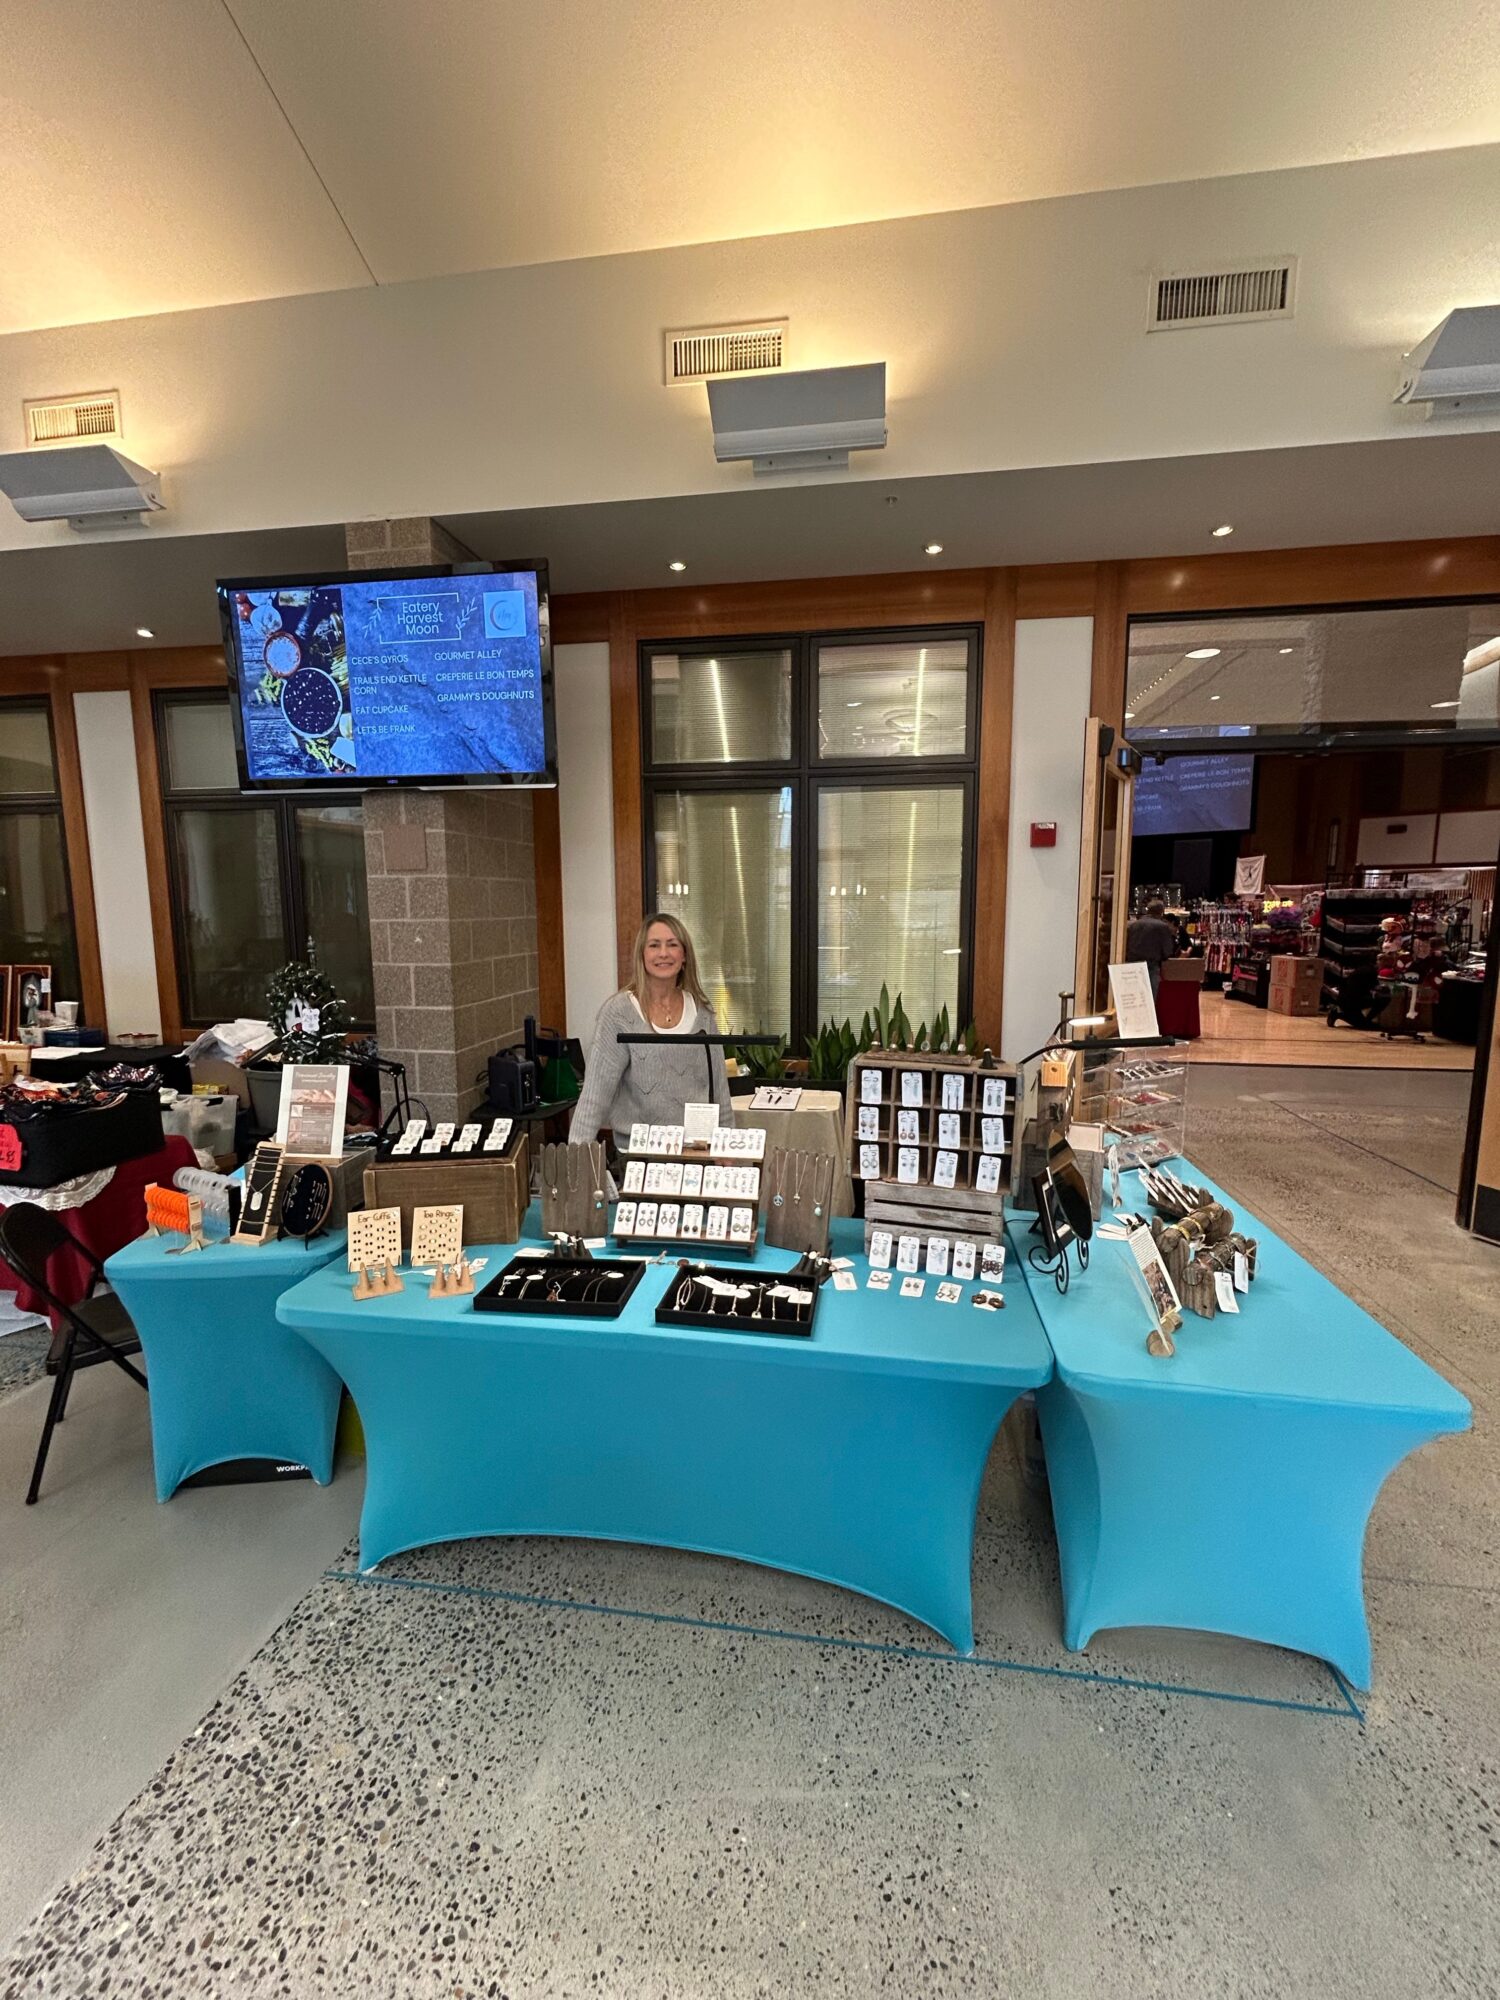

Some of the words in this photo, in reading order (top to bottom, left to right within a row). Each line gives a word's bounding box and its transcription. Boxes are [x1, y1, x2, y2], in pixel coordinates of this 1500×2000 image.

[402, 602, 440, 615] Eatery
[397, 612, 443, 625] Harvest
[406, 623, 440, 635] Moon
[351, 656, 380, 665] CECE'S
[381, 654, 409, 664] GYROS
[434, 650, 475, 661] GOURMET
[477, 649, 502, 659] ALLEY
[353, 676, 380, 685] TRAILS
[381, 675, 398, 684] END
[398, 673, 427, 683] KETTLE
[435, 672, 473, 682] CREPERIE
[475, 671, 485, 680] LE
[487, 670, 505, 680] BON
[506, 669, 535, 679] TEMPS
[354, 686, 377, 695] CORN
[437, 692, 480, 702] GRAMMY'S
[482, 690, 535, 701] DOUGHNUTS
[355, 706, 370, 715] FAT
[372, 704, 409, 714] CUPCAKE
[379, 725, 388, 734] BE
[390, 724, 416, 733] FRANK
[357, 1214, 371, 1224] Ear
[373, 1211, 391, 1221] Cuffs
[424, 1210, 434, 1219] Toe
[436, 1209, 454, 1220] Rings
